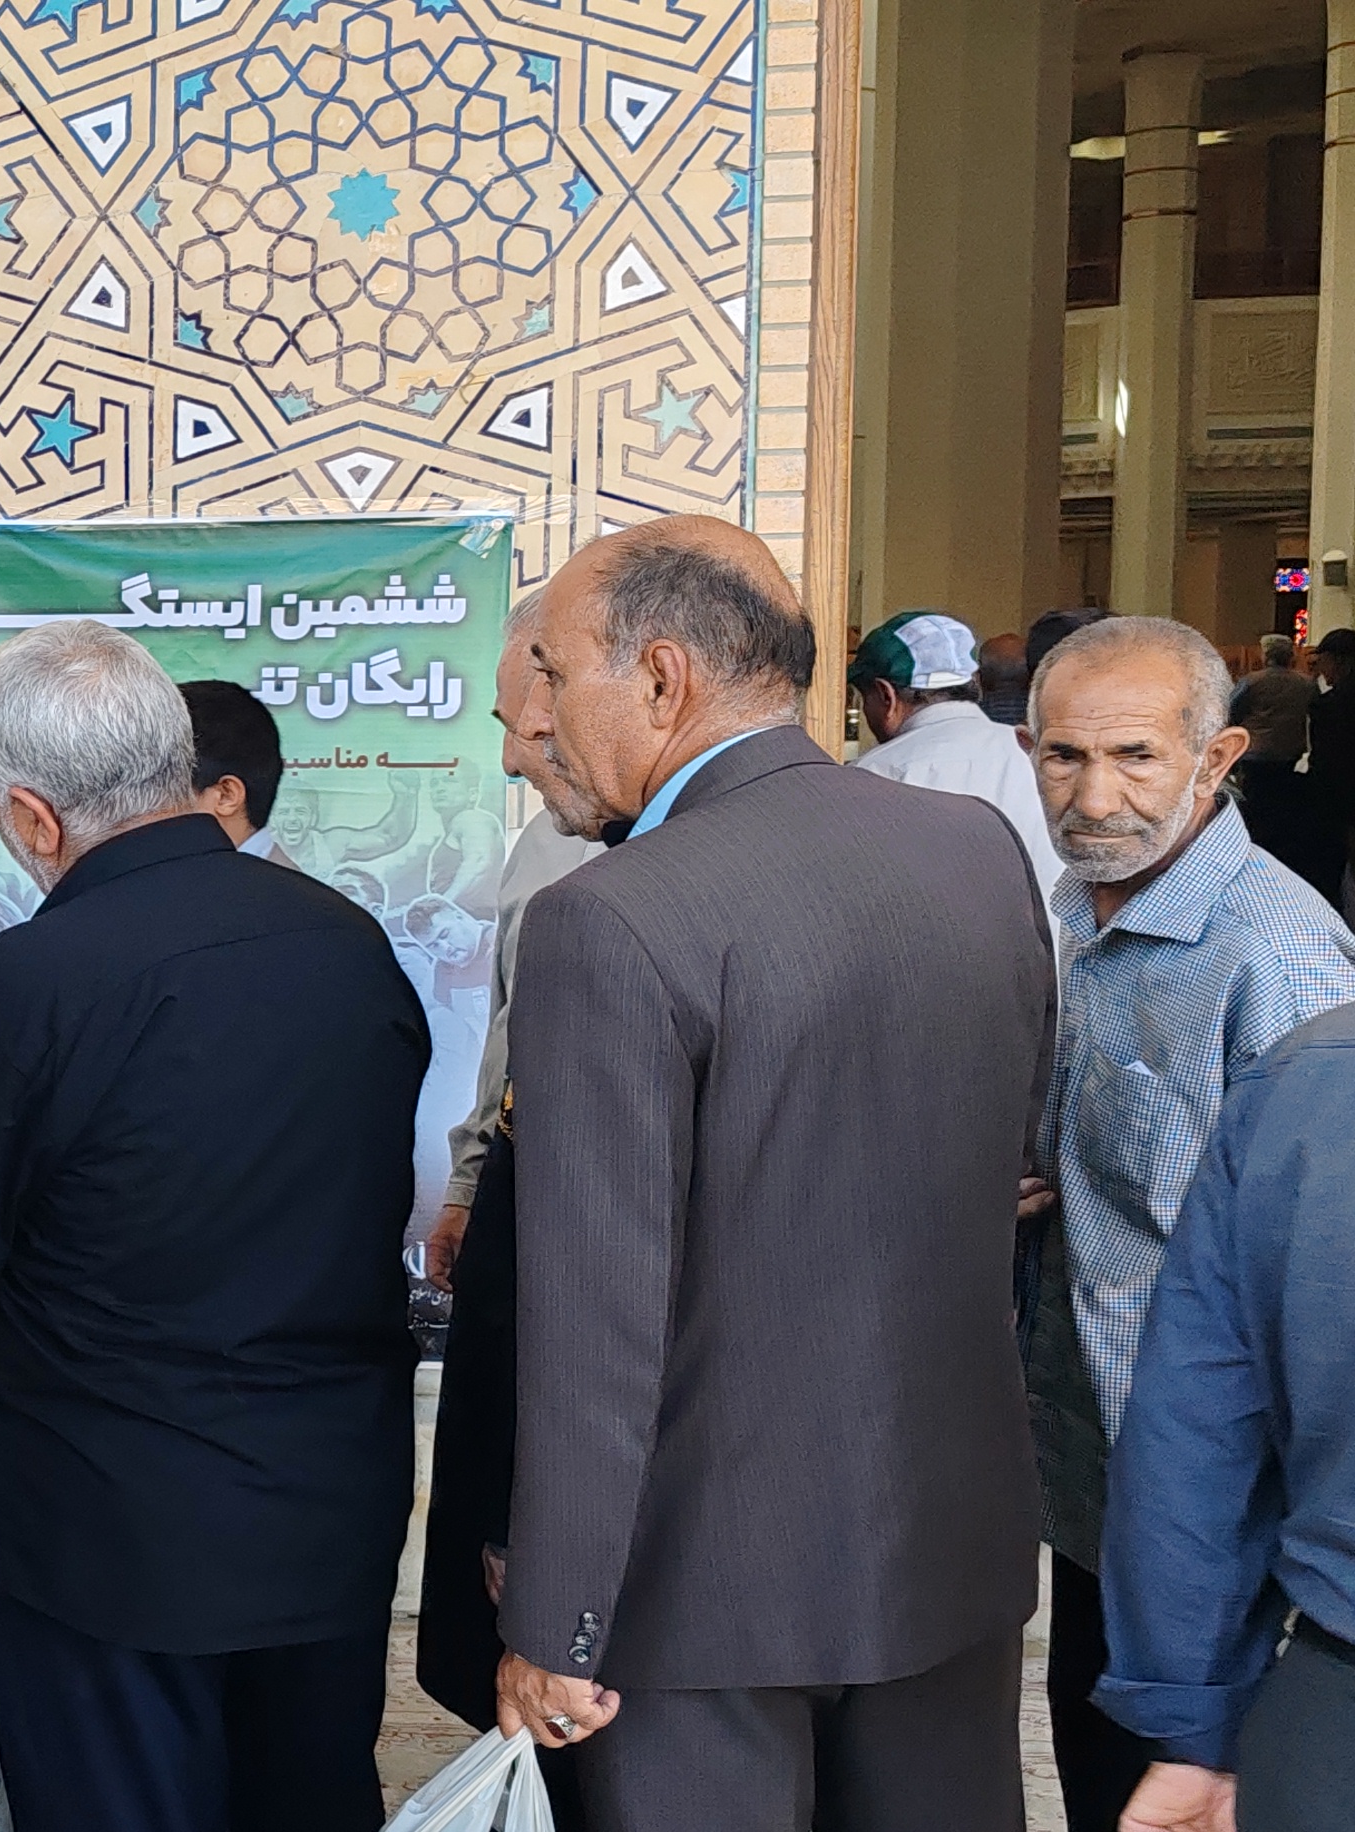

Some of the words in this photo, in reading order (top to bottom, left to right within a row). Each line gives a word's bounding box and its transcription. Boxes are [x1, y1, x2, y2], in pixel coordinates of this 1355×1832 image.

[271, 574, 467, 640] ششمین
[306, 648, 462, 719] رایگان
[282, 746, 369, 776] مناسب
